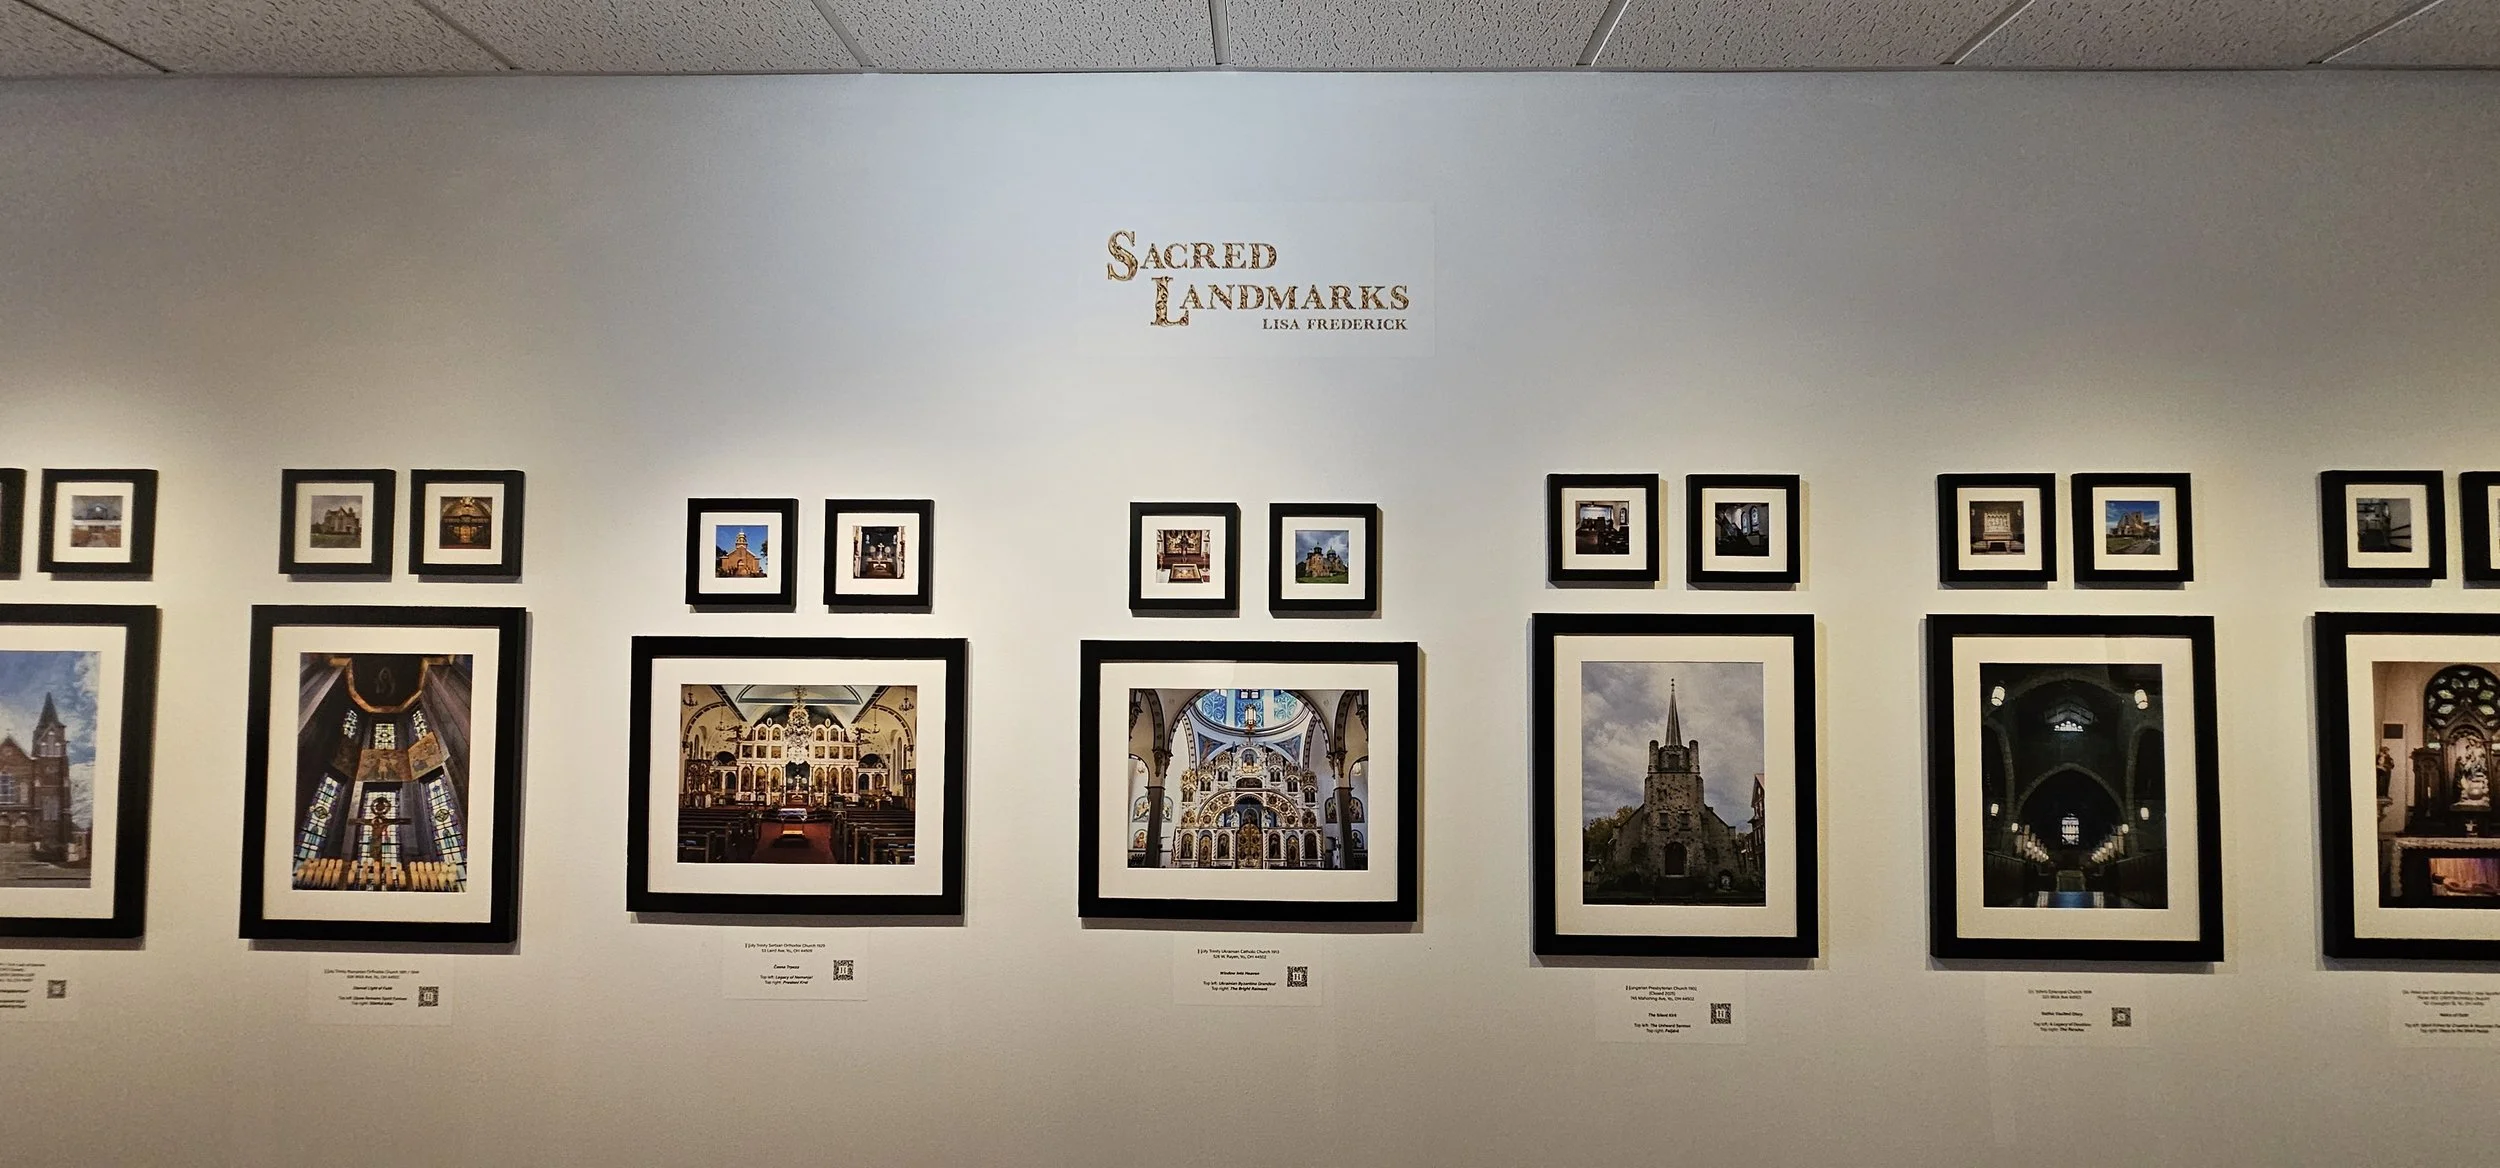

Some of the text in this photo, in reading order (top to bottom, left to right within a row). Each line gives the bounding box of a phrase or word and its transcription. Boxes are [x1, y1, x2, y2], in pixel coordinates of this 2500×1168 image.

[1107, 229, 1277, 281] SACRED
[1150, 276, 1410, 327] LANDMARKS
[1262, 318, 1408, 331] LISA FREDERICK
